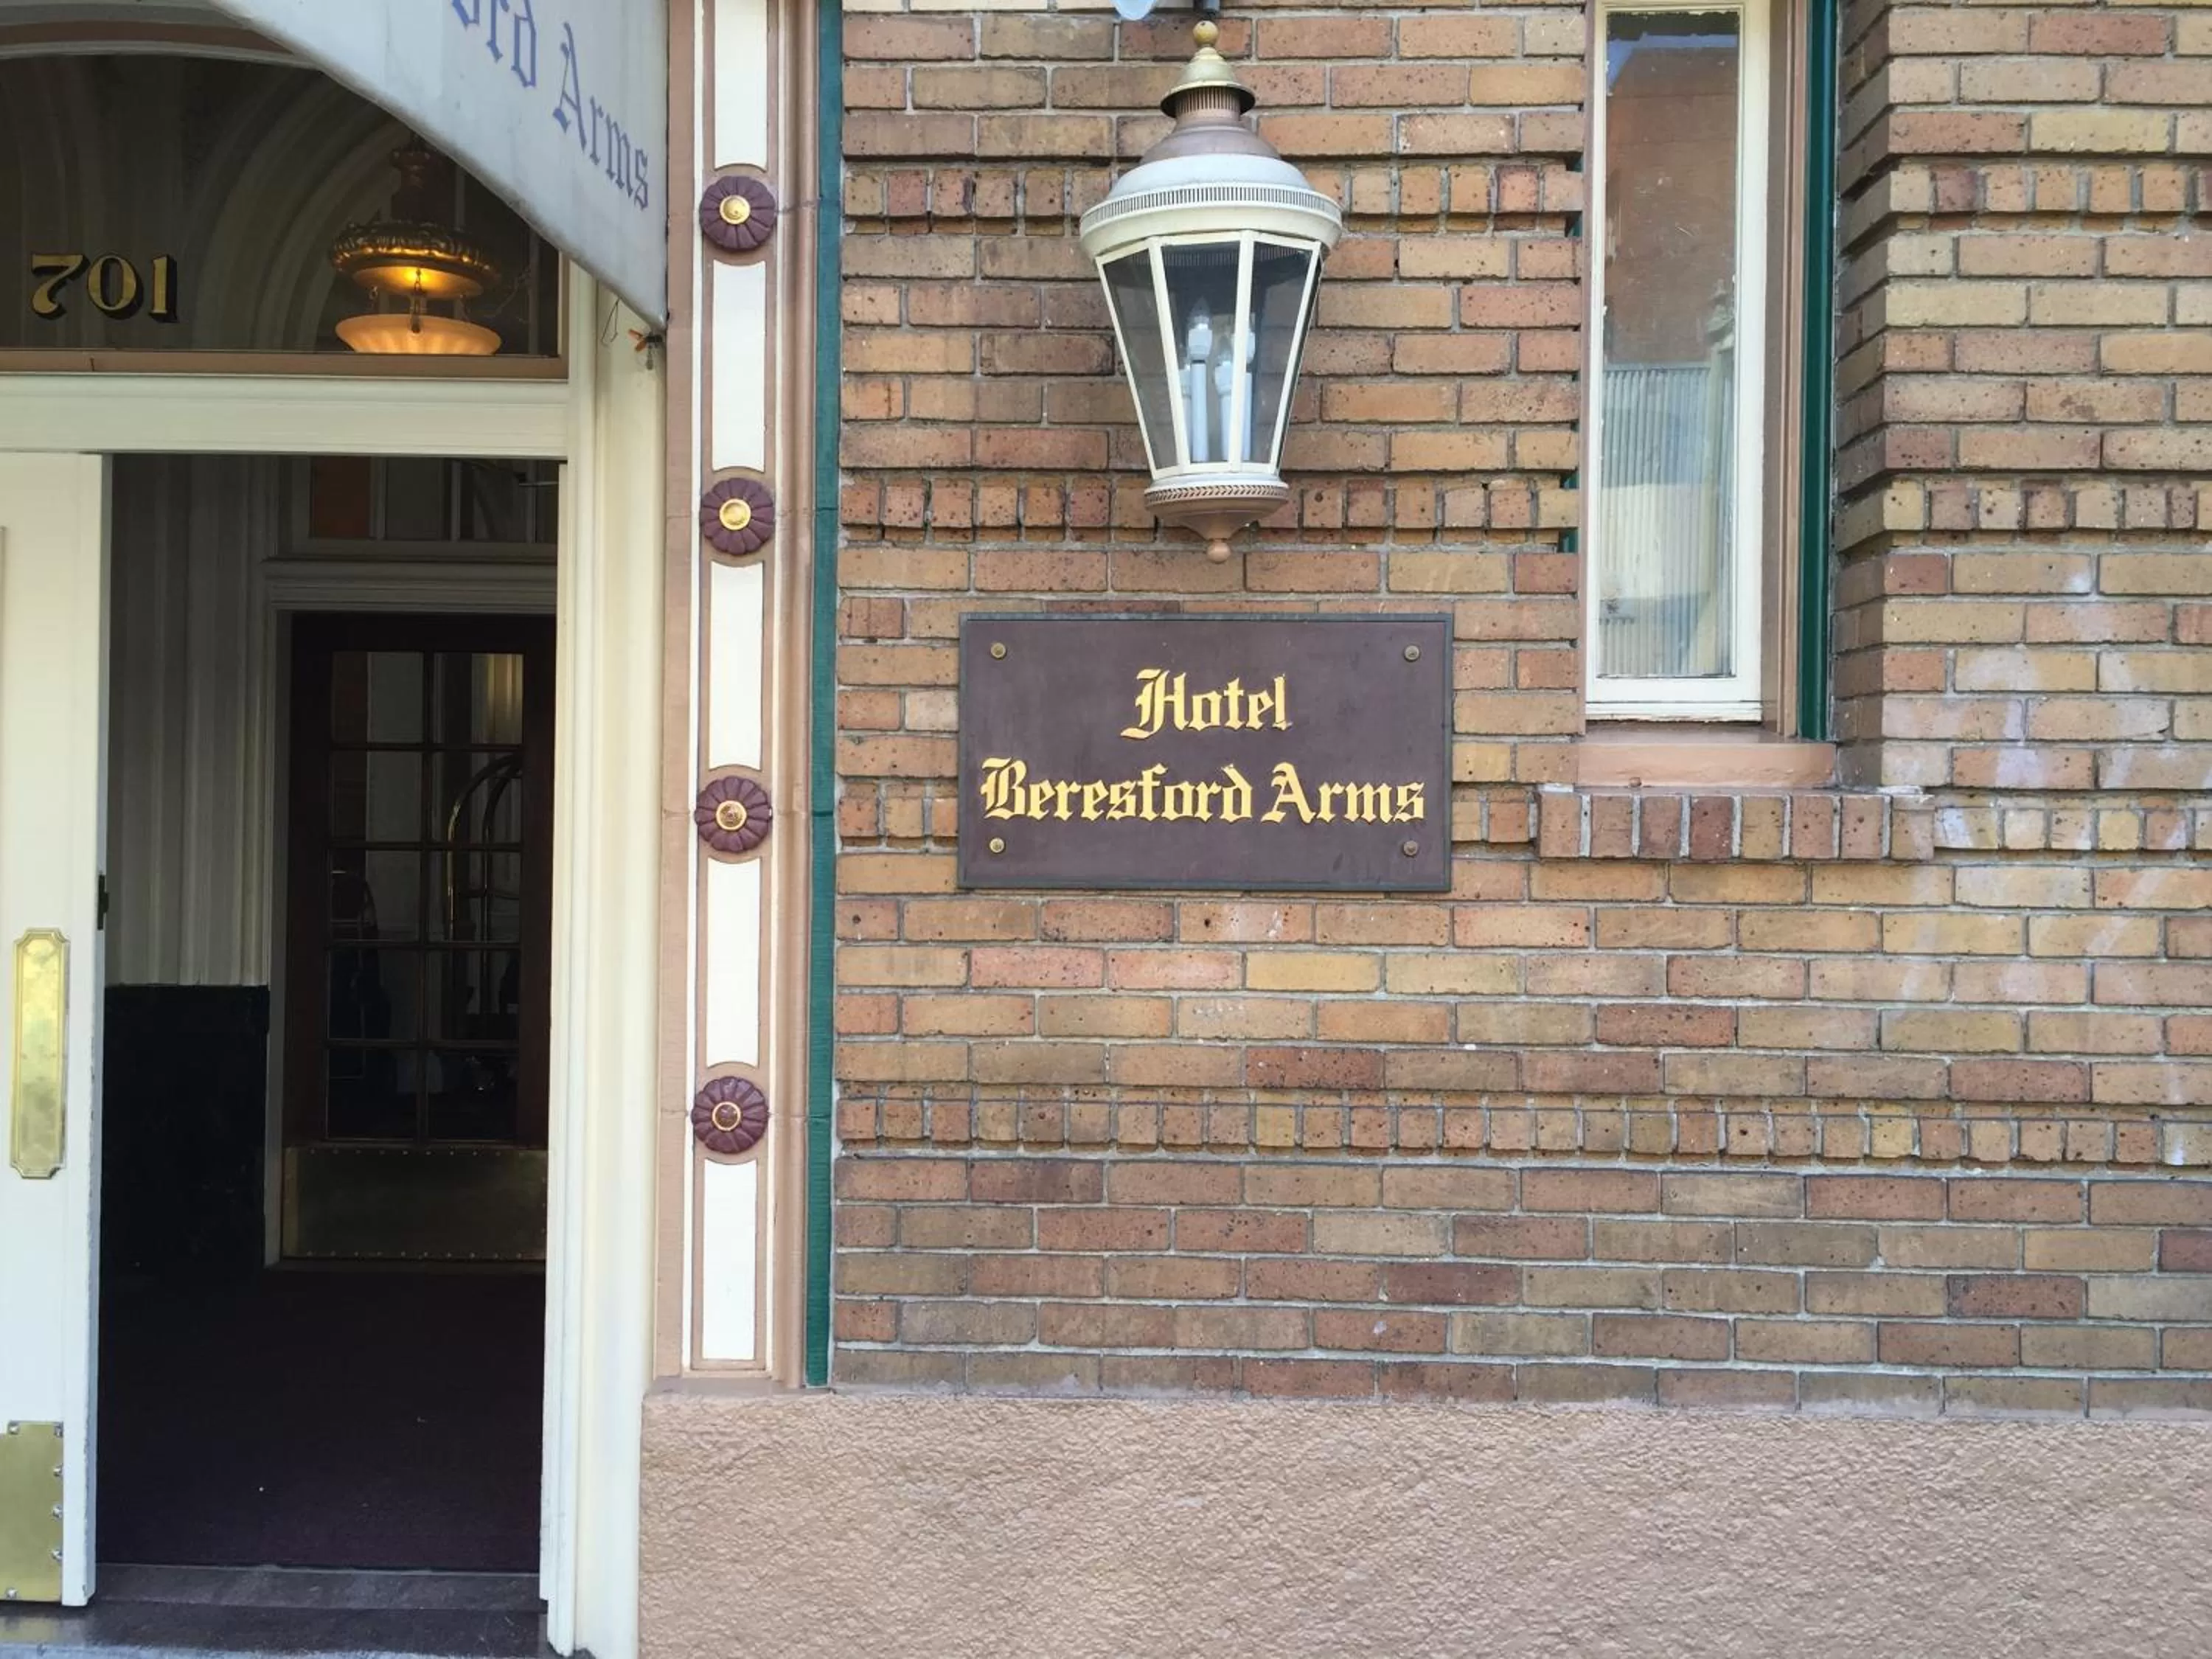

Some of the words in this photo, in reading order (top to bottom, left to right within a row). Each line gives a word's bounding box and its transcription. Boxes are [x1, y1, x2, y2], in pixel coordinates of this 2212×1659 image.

[552, 21, 648, 211] Arms
[31, 252, 173, 317] 701
[1121, 669, 1292, 740] Hotel
[980, 757, 1253, 824] Beresford
[1259, 761, 1426, 824] Arms
